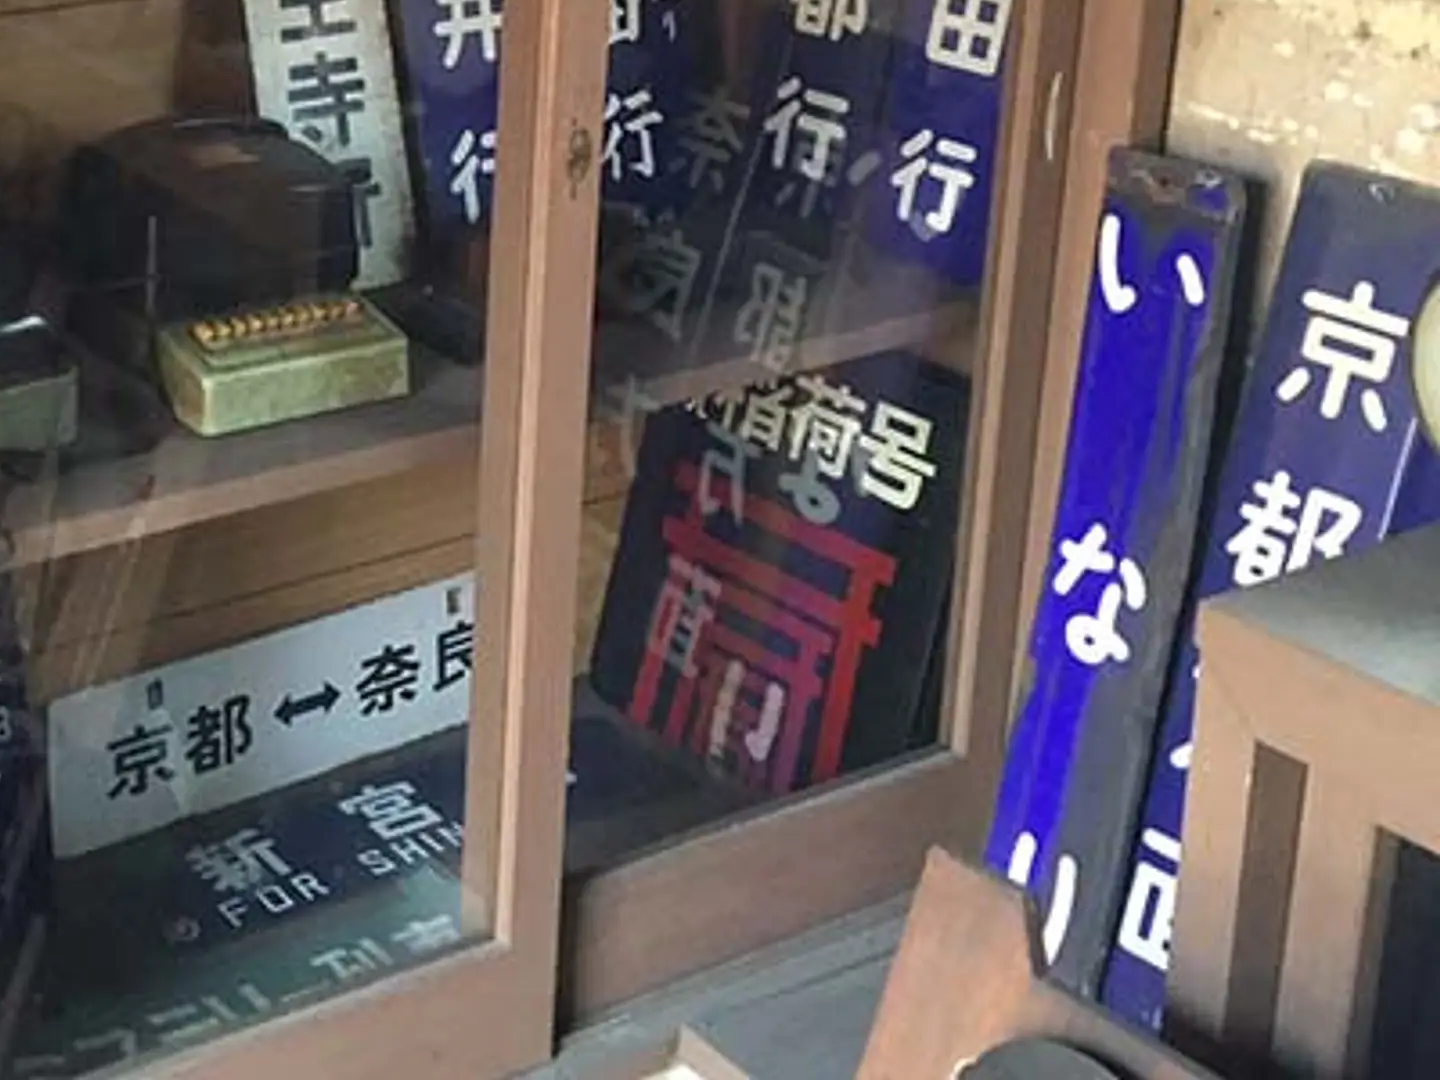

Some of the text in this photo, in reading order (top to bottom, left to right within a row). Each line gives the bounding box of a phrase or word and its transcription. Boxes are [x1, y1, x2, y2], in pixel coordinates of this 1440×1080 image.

[1008, 213, 1206, 965] いなり
[106, 621, 475, 800] 京都 奈良
[216, 870, 331, 930] FOR
